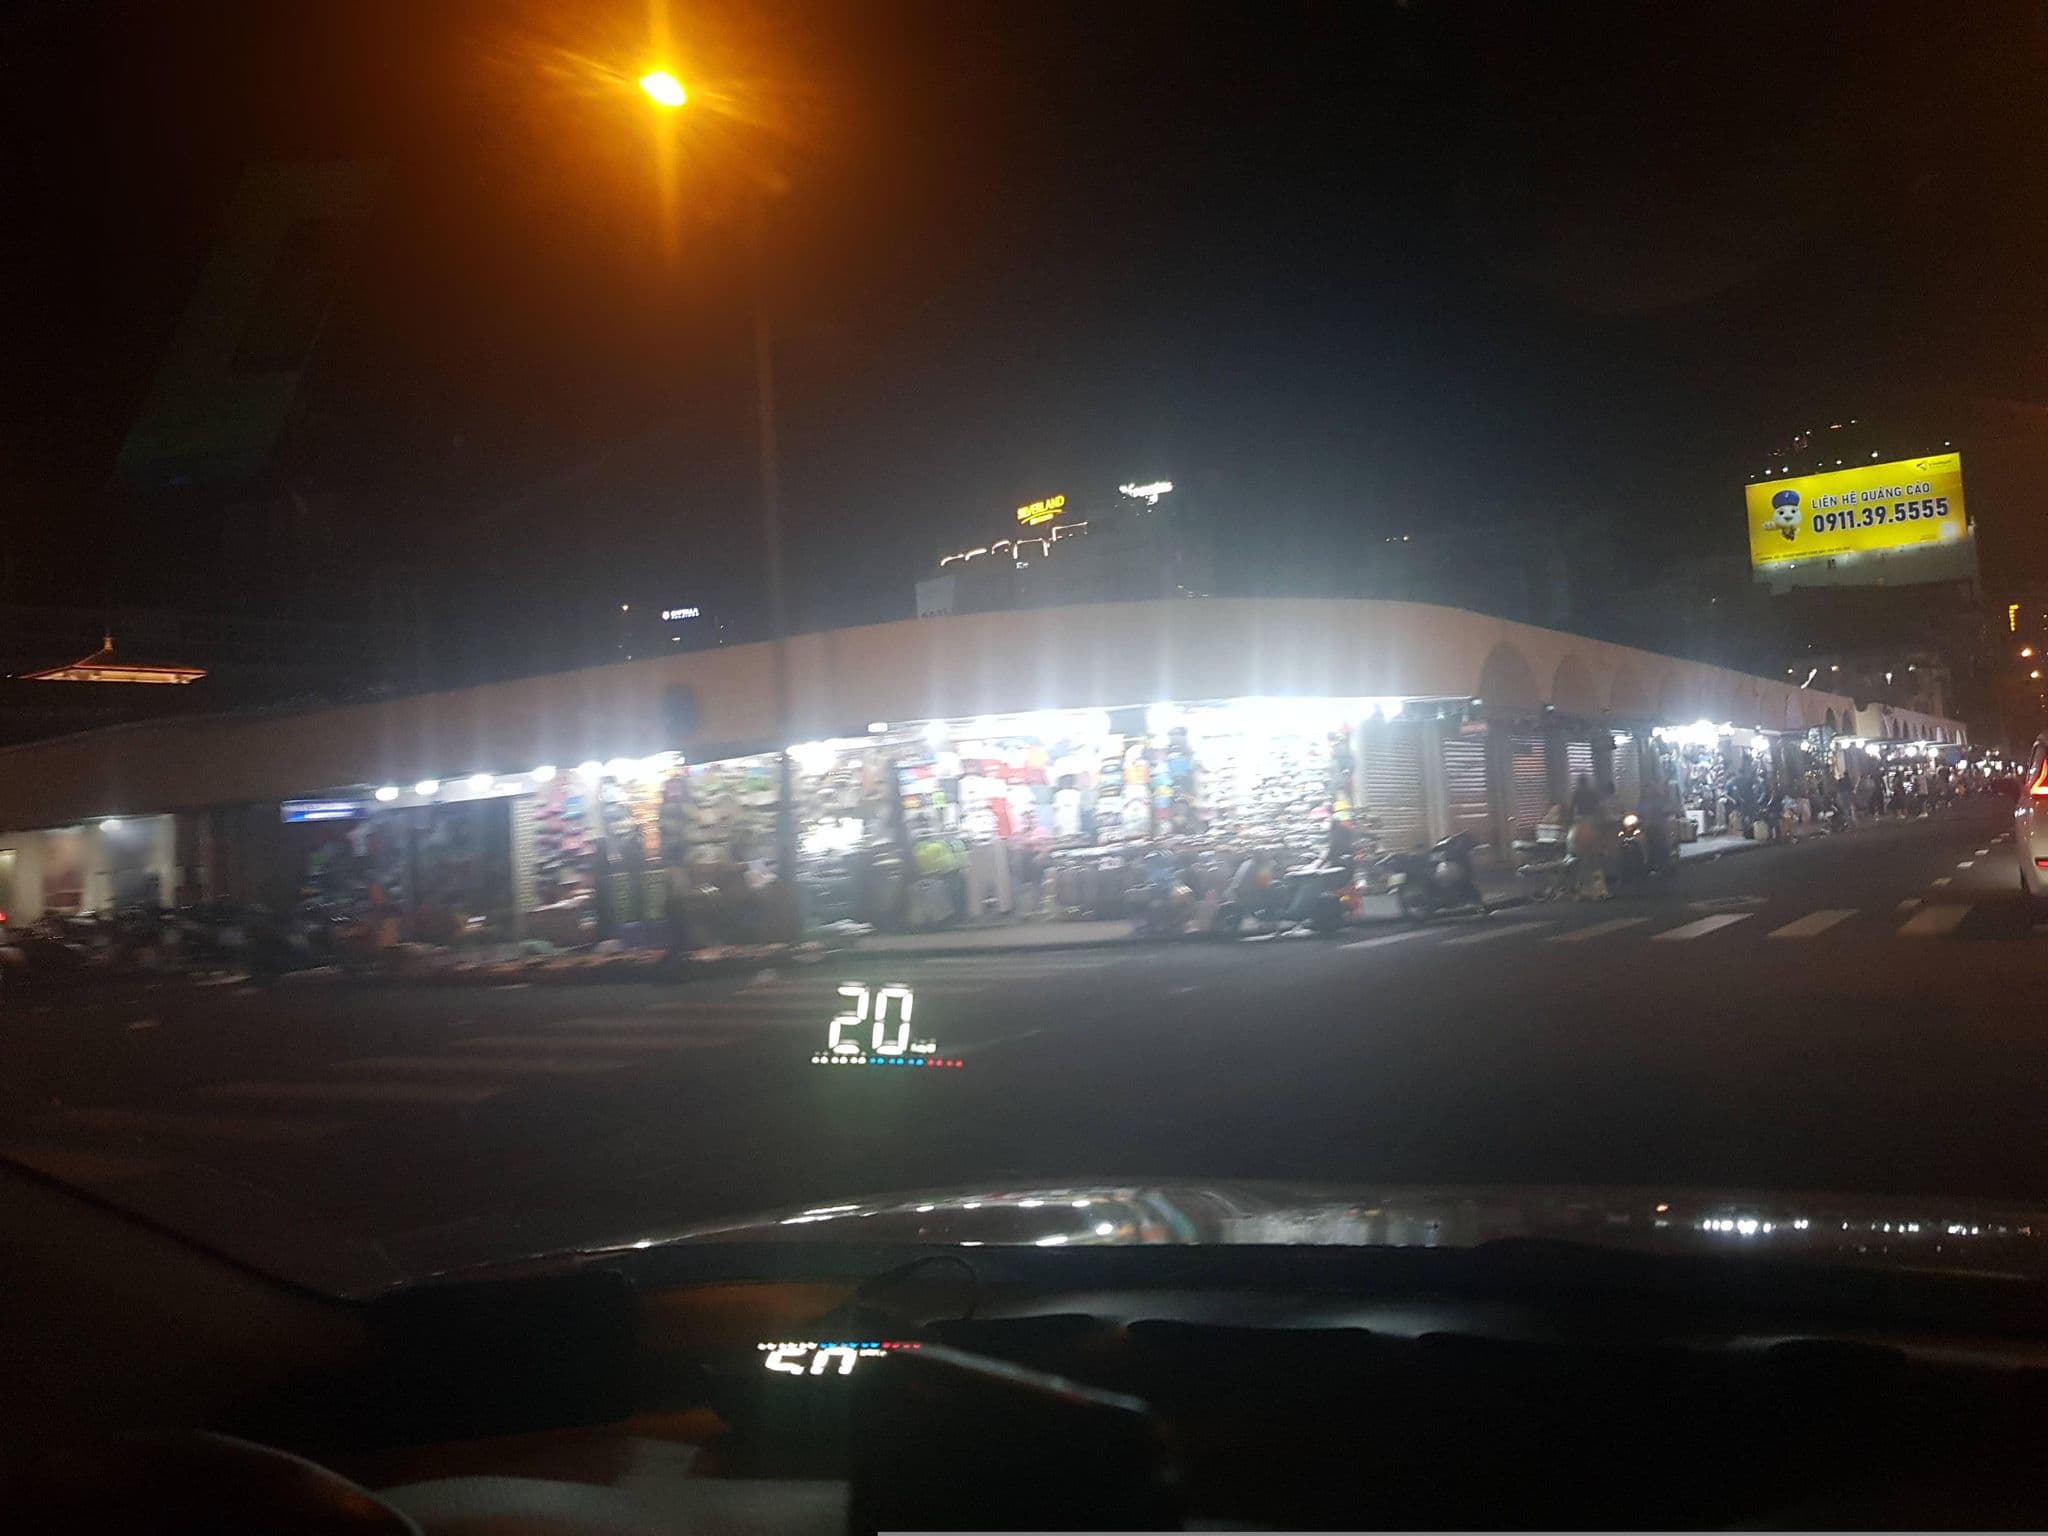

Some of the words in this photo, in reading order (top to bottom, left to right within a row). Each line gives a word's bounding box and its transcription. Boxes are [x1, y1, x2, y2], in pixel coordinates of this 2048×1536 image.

[1812, 495, 1837, 509] LIÊN
[1813, 498, 1948, 532] 0911.39.5555
[828, 983, 914, 1055] 20
